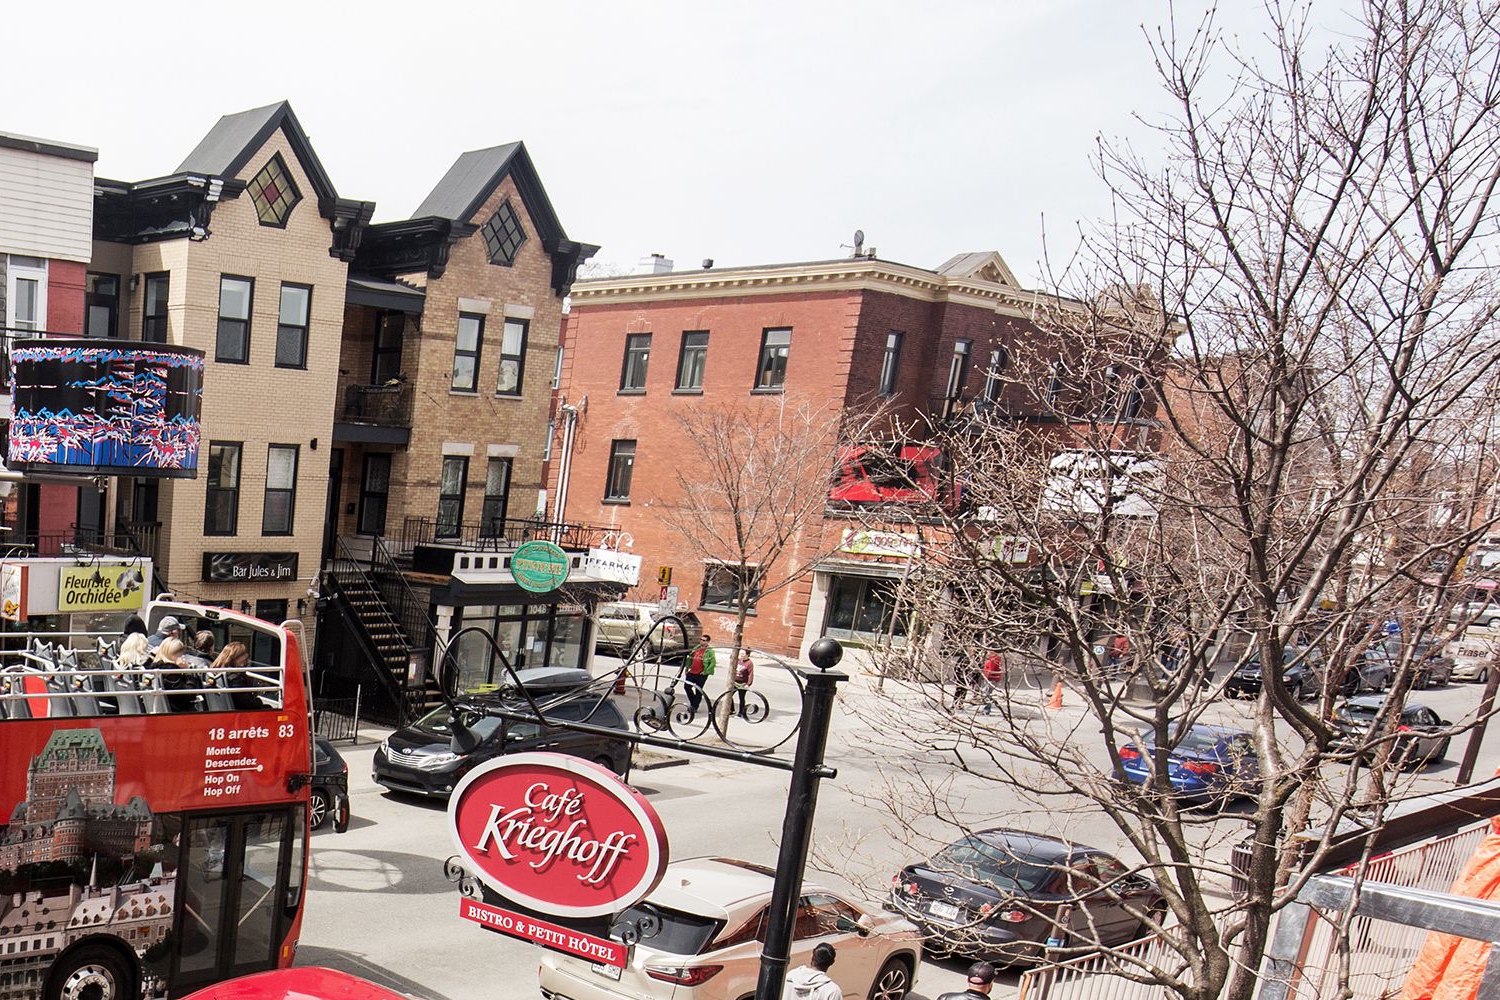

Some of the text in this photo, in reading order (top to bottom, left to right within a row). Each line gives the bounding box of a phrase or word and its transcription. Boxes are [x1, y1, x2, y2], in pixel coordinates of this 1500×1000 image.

[233, 564, 291, 579] Bar Jules & Jim
[66, 589, 122, 605] Orchidée
[530, 603, 546, 614] 1048
[1456, 646, 1490, 658] Fraser
[208, 726, 269, 740] 18 arrêts
[278, 724, 294, 738] 83
[206, 746, 241, 756] Montez
[205, 757, 257, 768] Descendez
[205, 774, 240, 785] Hop On
[204, 785, 241, 797] Hop Off
[523, 782, 584, 823] Café
[473, 803, 636, 884] Krieghoff
[468, 906, 616, 962] BISTRO & PETIT HÔTEL
